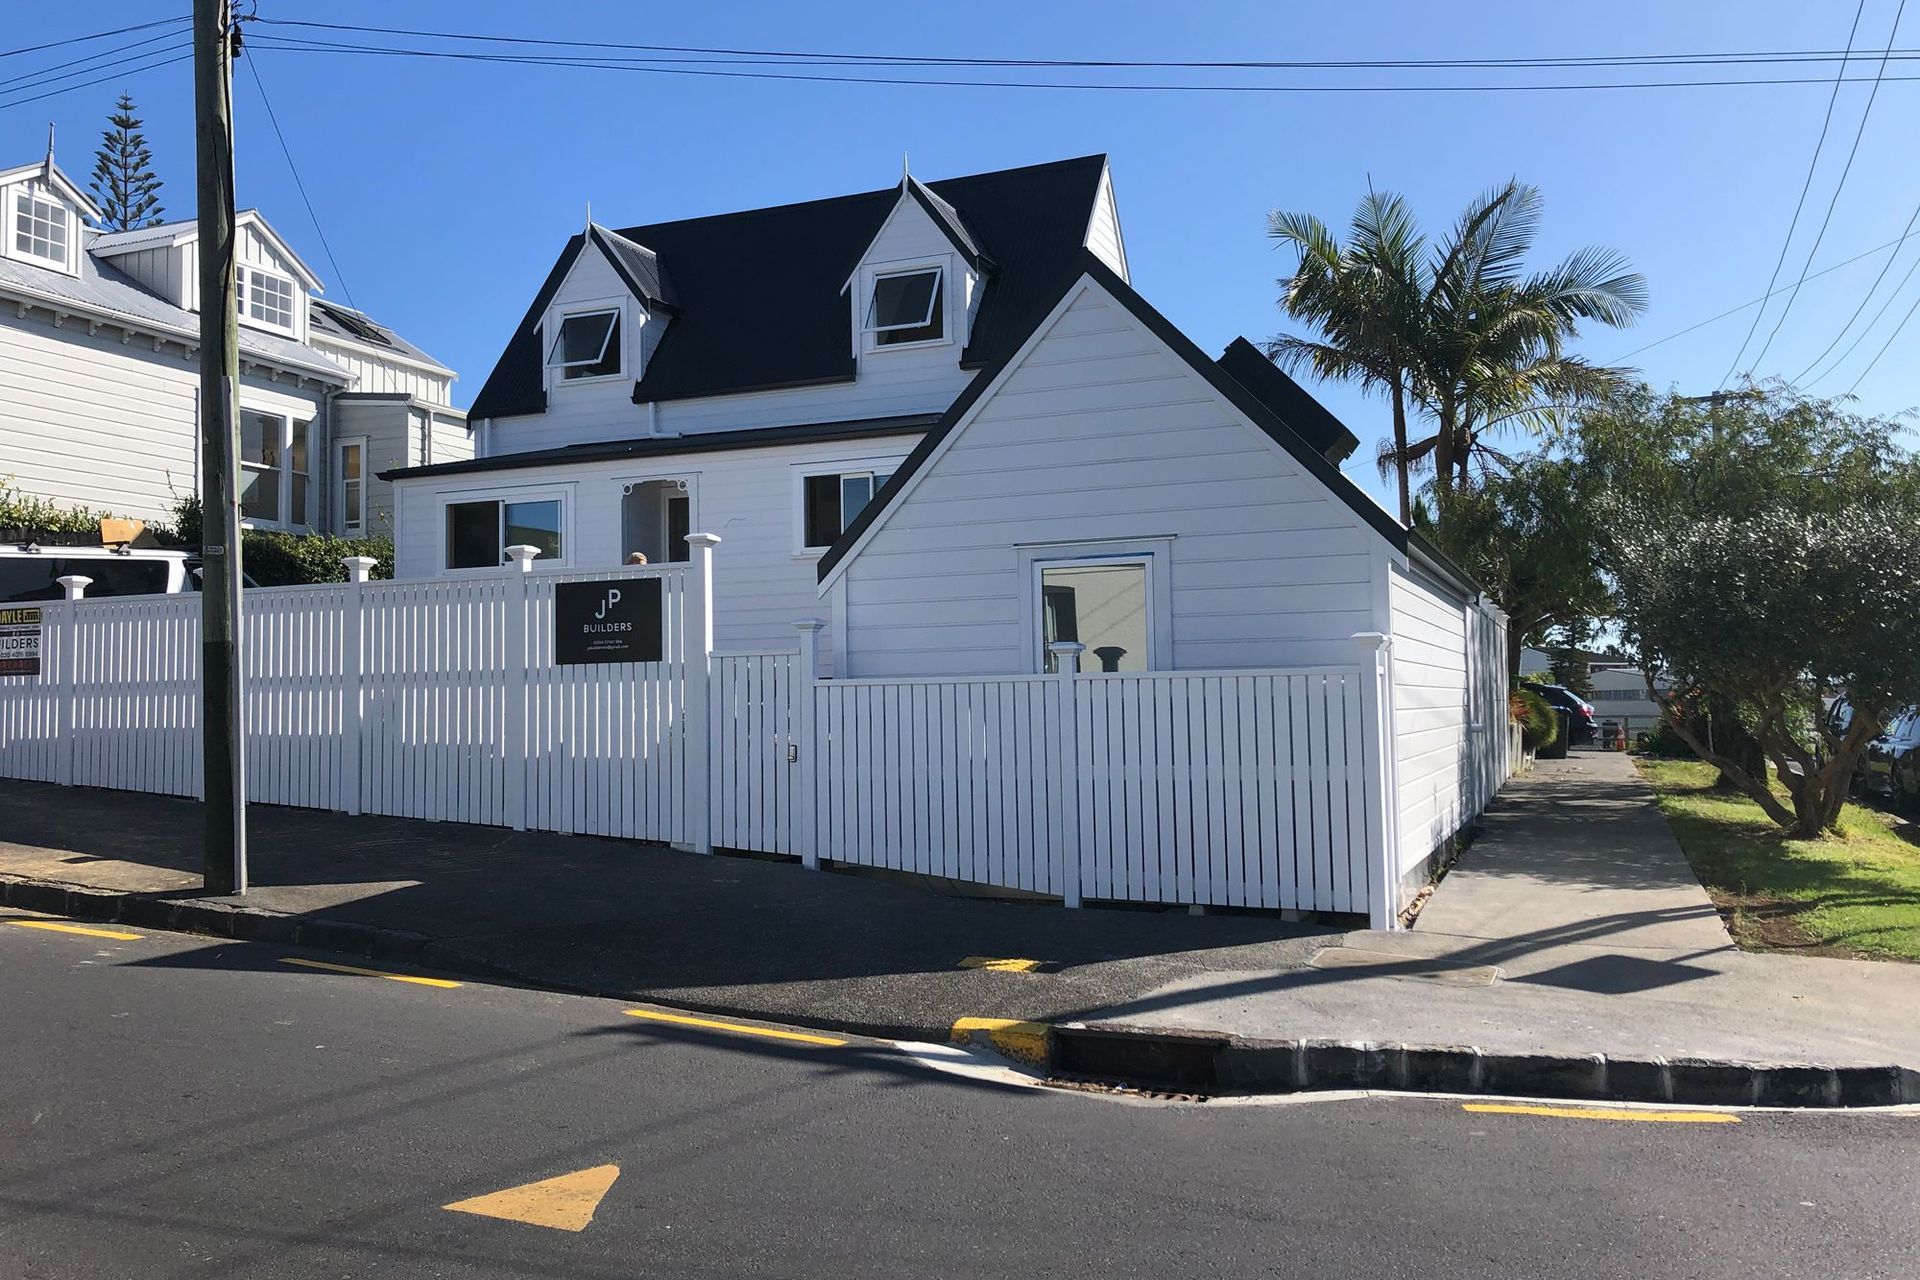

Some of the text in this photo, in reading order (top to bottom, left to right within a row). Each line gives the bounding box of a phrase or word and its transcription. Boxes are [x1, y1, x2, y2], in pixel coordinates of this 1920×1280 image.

[0, 610, 22, 624] AYLE
[583, 622, 632, 632] BUILDERS
[0, 638, 39, 649] ILDERS
